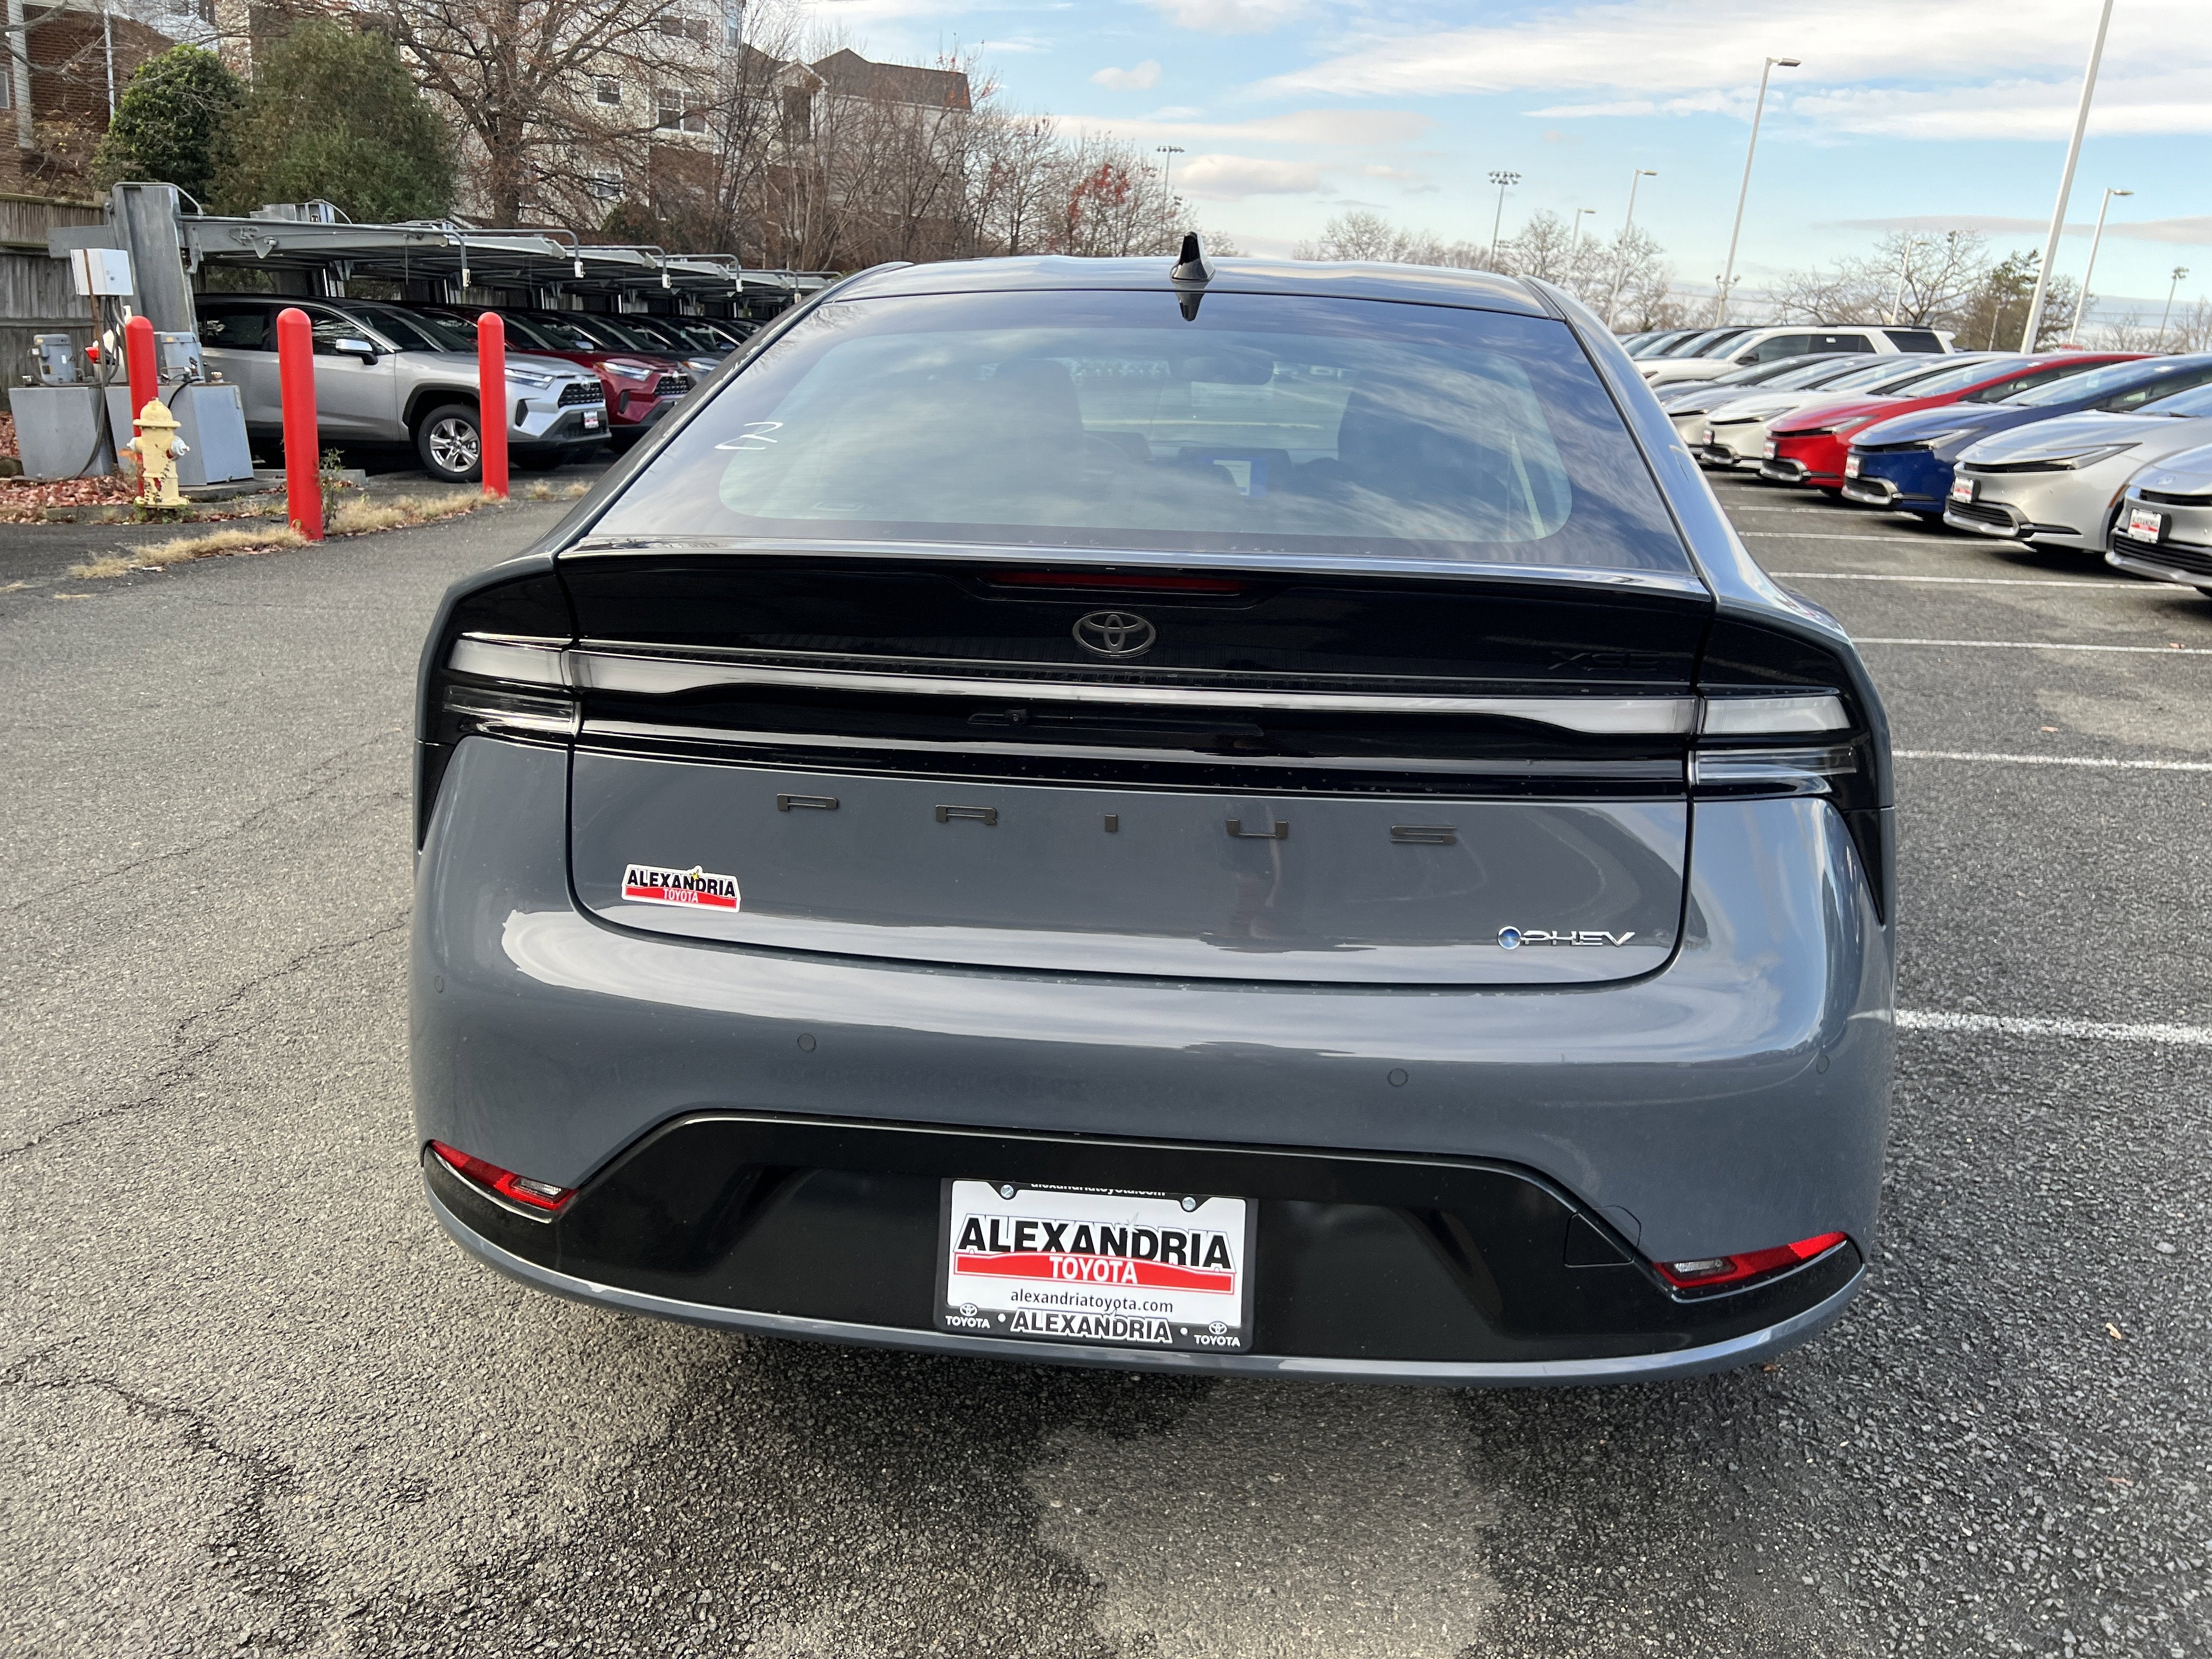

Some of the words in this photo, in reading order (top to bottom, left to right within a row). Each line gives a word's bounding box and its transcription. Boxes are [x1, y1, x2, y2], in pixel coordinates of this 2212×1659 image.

[777, 793, 1457, 845] PRIUS
[627, 869, 735, 897] ALEXANDRIA
[663, 888, 698, 903] TOYOTA
[1522, 930, 1636, 946] PHEV
[958, 1217, 1232, 1269] ALEXANDRIA
[1048, 1256, 1138, 1284] TOYOTA
[1011, 1289, 1173, 1313] alexandriatoyota.com
[945, 1315, 991, 1329] TOYOTA
[1012, 1310, 1173, 1344] ALEXANDRIA
[1194, 1334, 1241, 1348] TOYOTA
